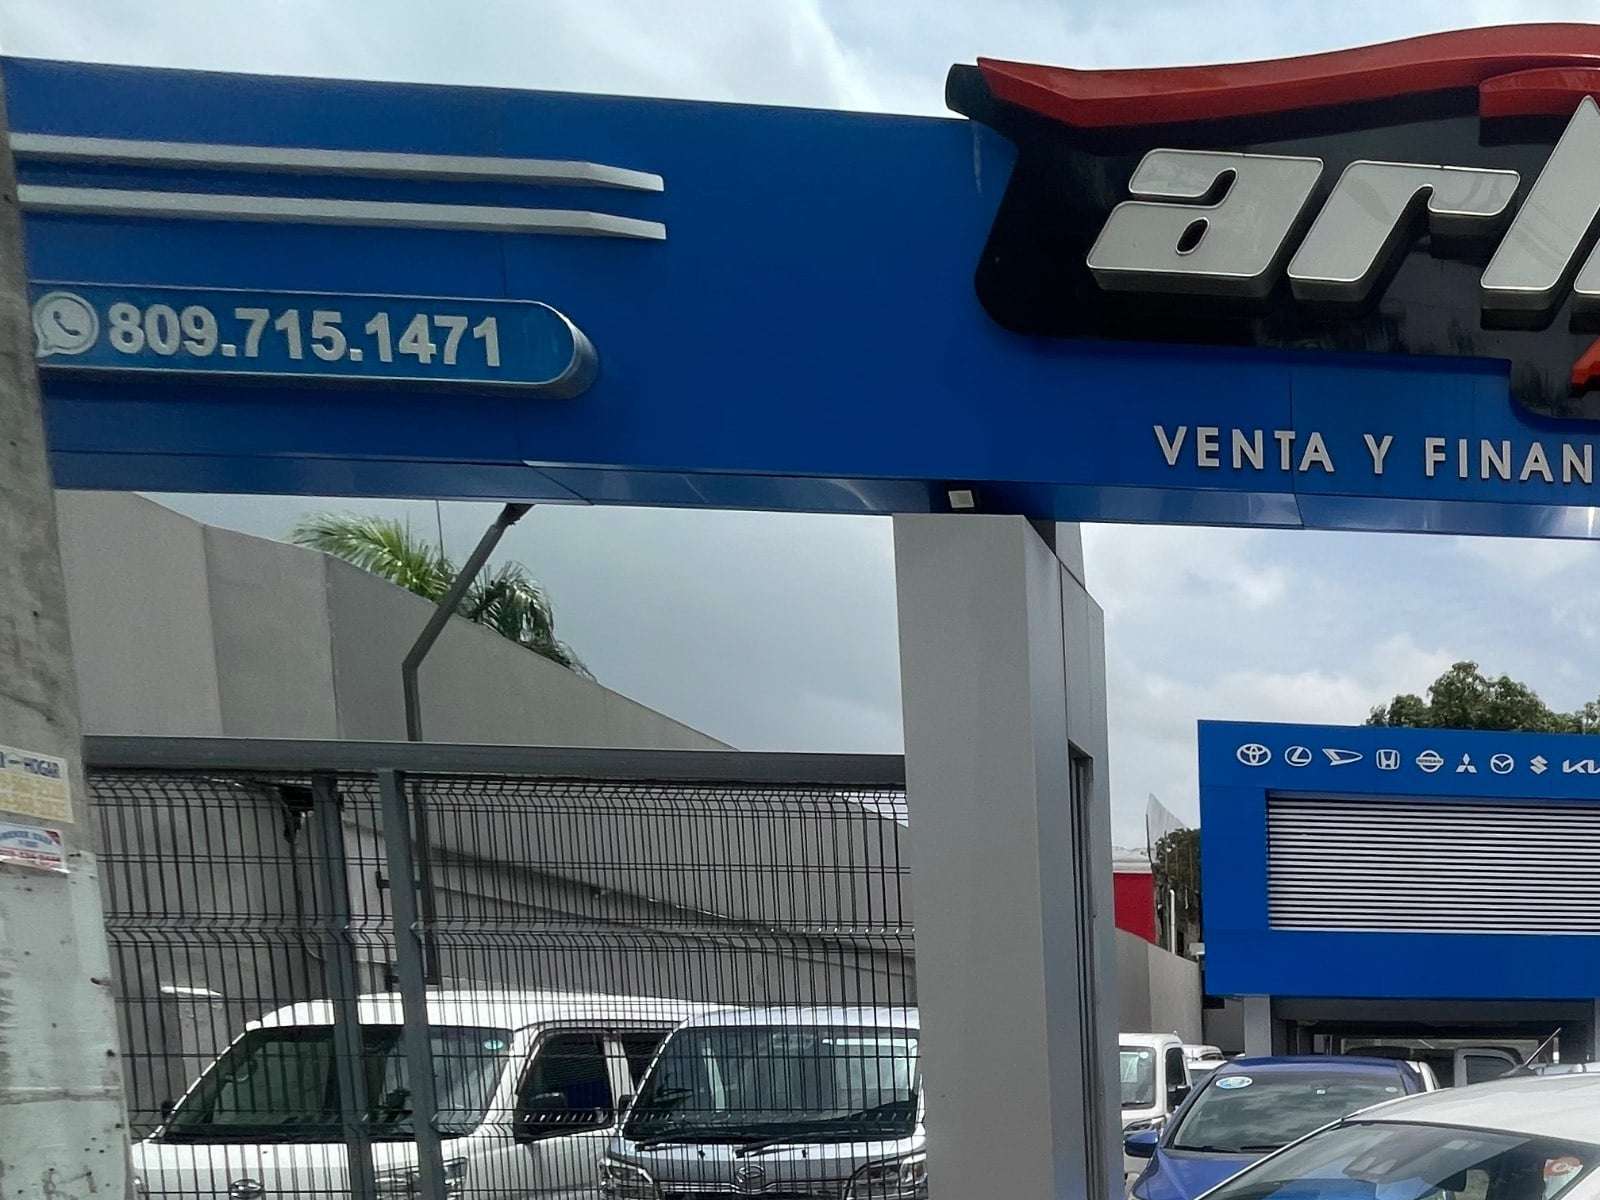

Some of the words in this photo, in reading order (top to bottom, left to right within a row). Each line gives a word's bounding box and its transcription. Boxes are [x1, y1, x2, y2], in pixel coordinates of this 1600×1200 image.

[108, 302, 500, 367] 809.715.1471
[1153, 425, 1335, 473] VENTA
[1363, 433, 1393, 475] Y
